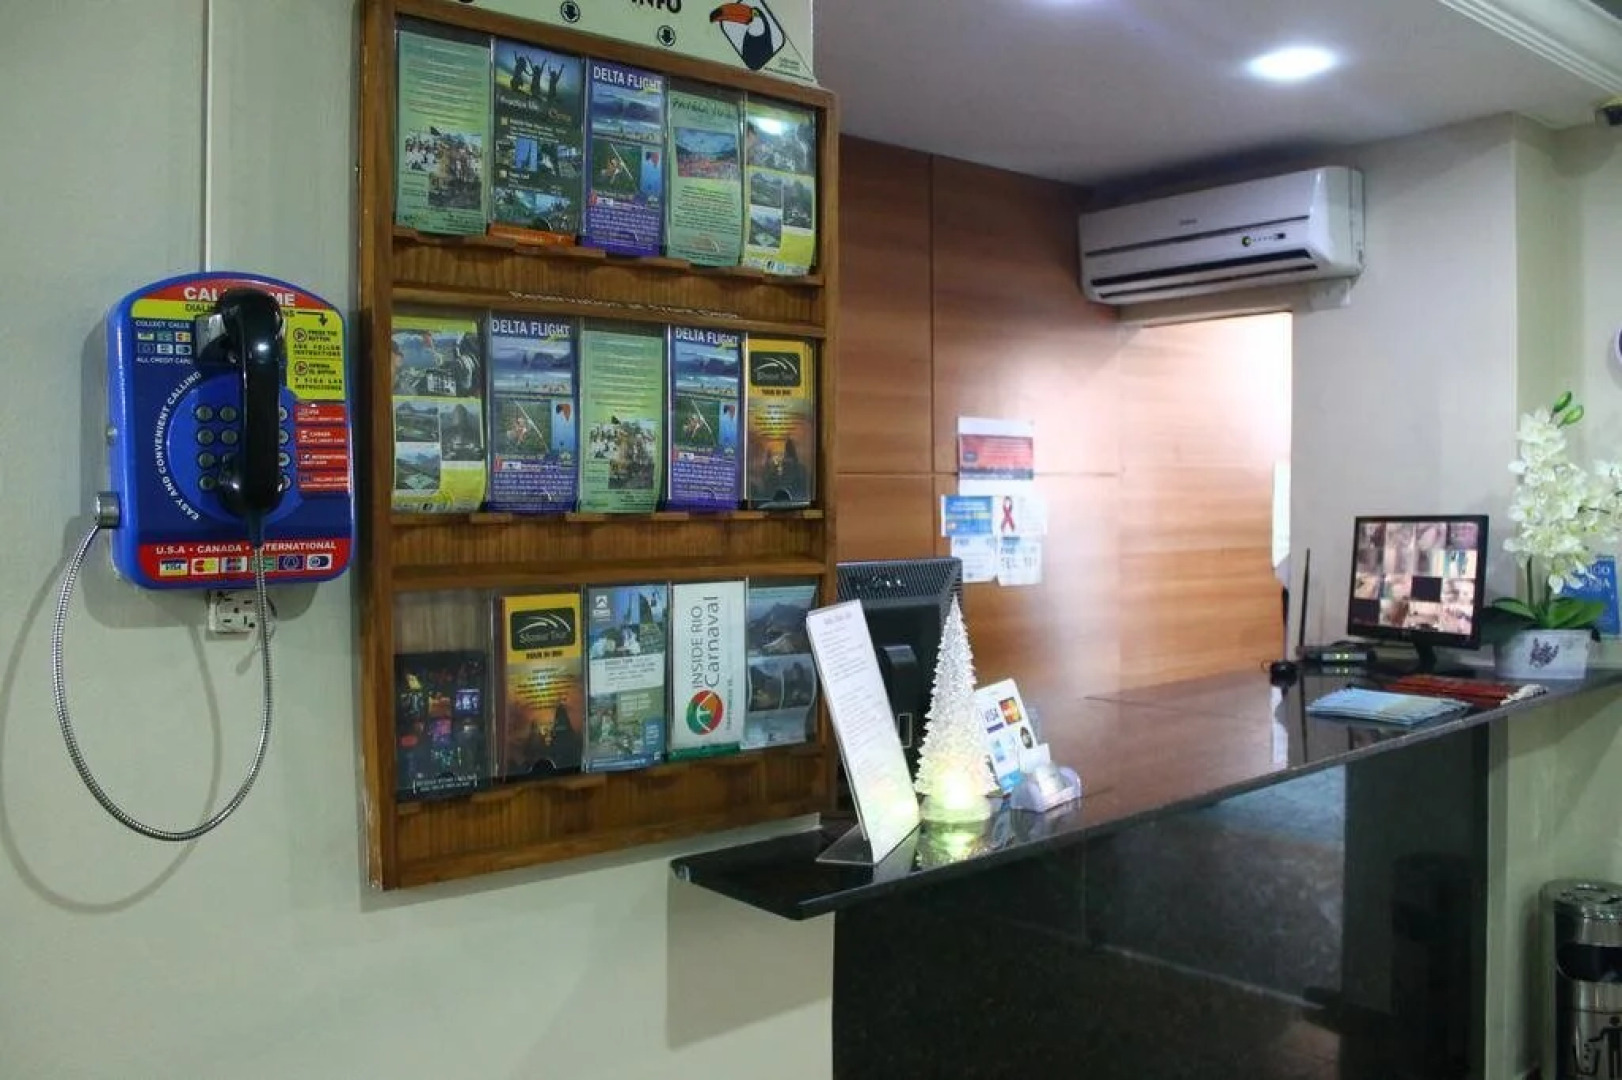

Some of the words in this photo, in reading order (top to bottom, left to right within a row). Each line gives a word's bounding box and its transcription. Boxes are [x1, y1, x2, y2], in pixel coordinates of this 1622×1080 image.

[593, 65, 624, 83] DELTA
[626, 73, 662, 90] FLIGHT
[184, 286, 228, 302] CAL
[492, 319, 527, 335] DELTA
[531, 322, 571, 338] FLIGHT
[675, 327, 705, 342] DELTA
[707, 330, 738, 347] FLIGHT
[167, 370, 202, 406] CALLING
[154, 404, 171, 475] CONVENIENT
[162, 476, 179, 497] AND
[176, 497, 200, 521] EASY
[197, 544, 242, 553] CANADA
[262, 540, 336, 552] TERNATIONAL
[690, 606, 704, 633] RIO
[703, 596, 720, 688] Carnaval
[691, 637, 704, 689] INSIDE
